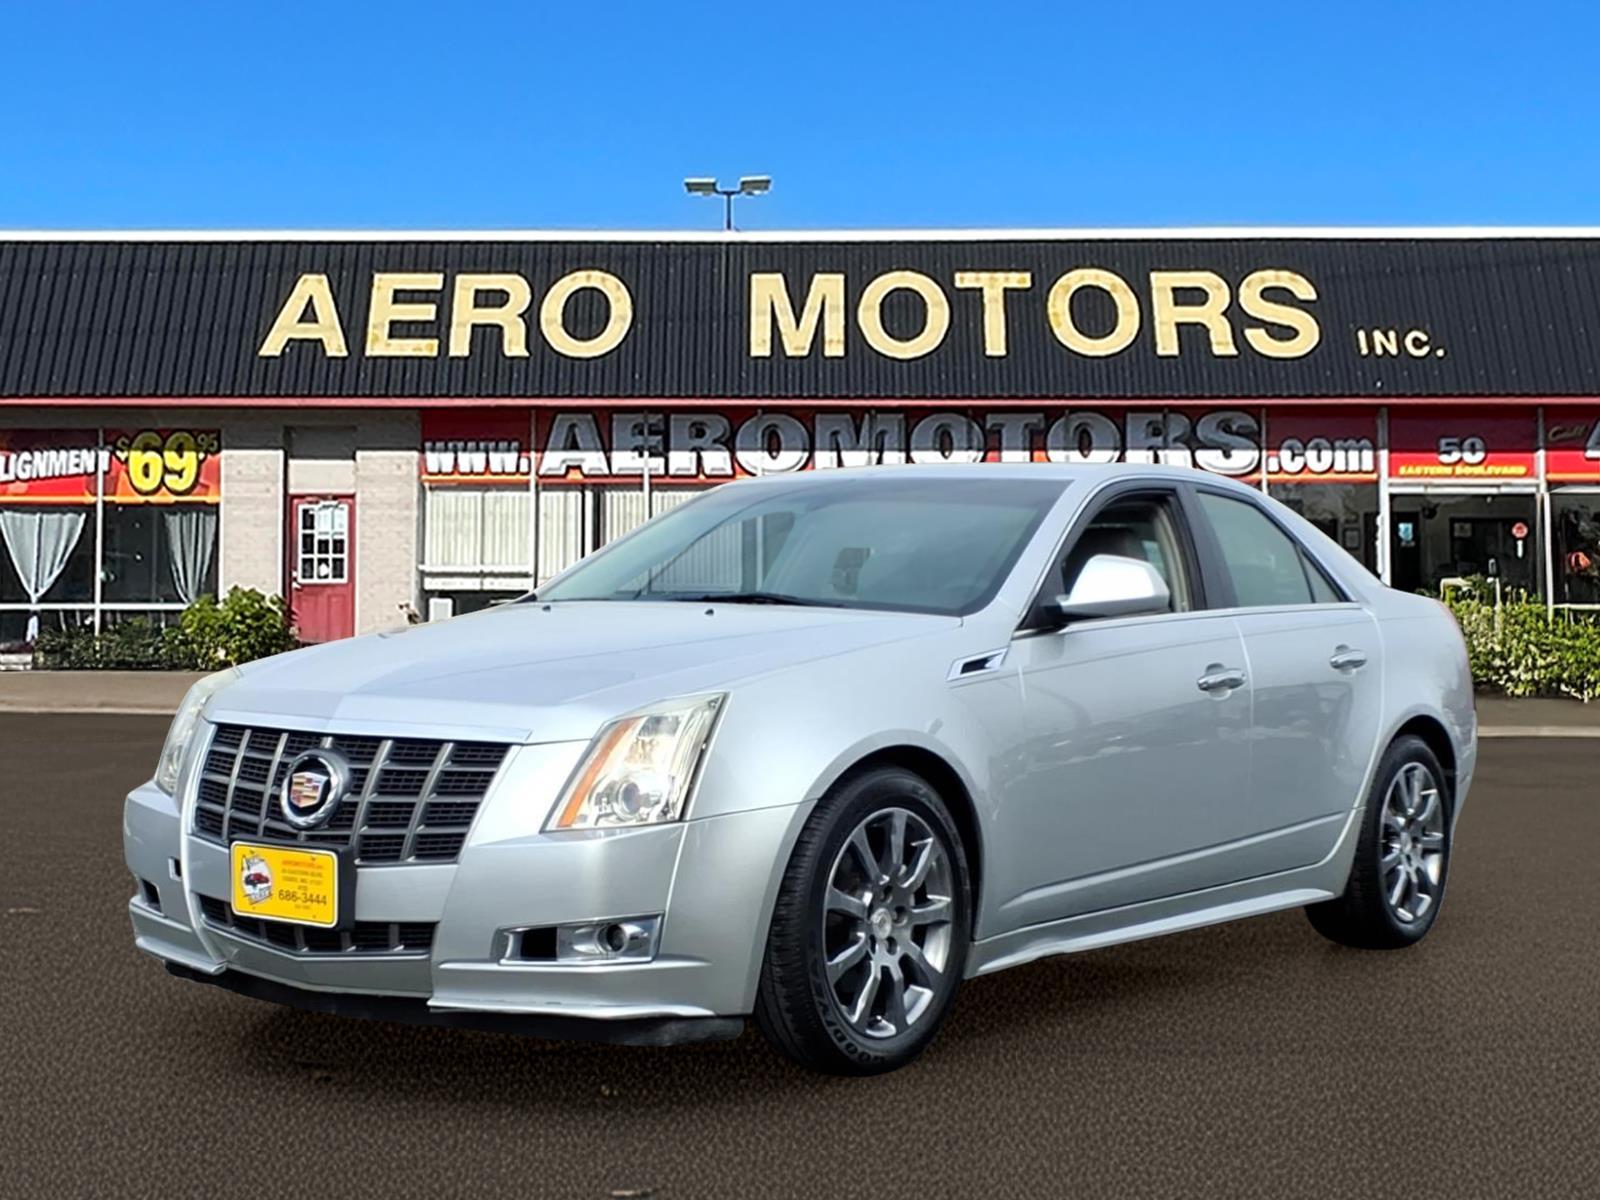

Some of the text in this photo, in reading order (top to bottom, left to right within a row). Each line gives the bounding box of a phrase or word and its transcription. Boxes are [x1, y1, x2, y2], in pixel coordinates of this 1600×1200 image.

[258, 268, 1446, 360] AERO MOTORS INC.
[1438, 437, 1486, 464] 50
[1399, 465, 1527, 476] EASTERN BOULEVARD
[278, 889, 327, 906] 686-3444
